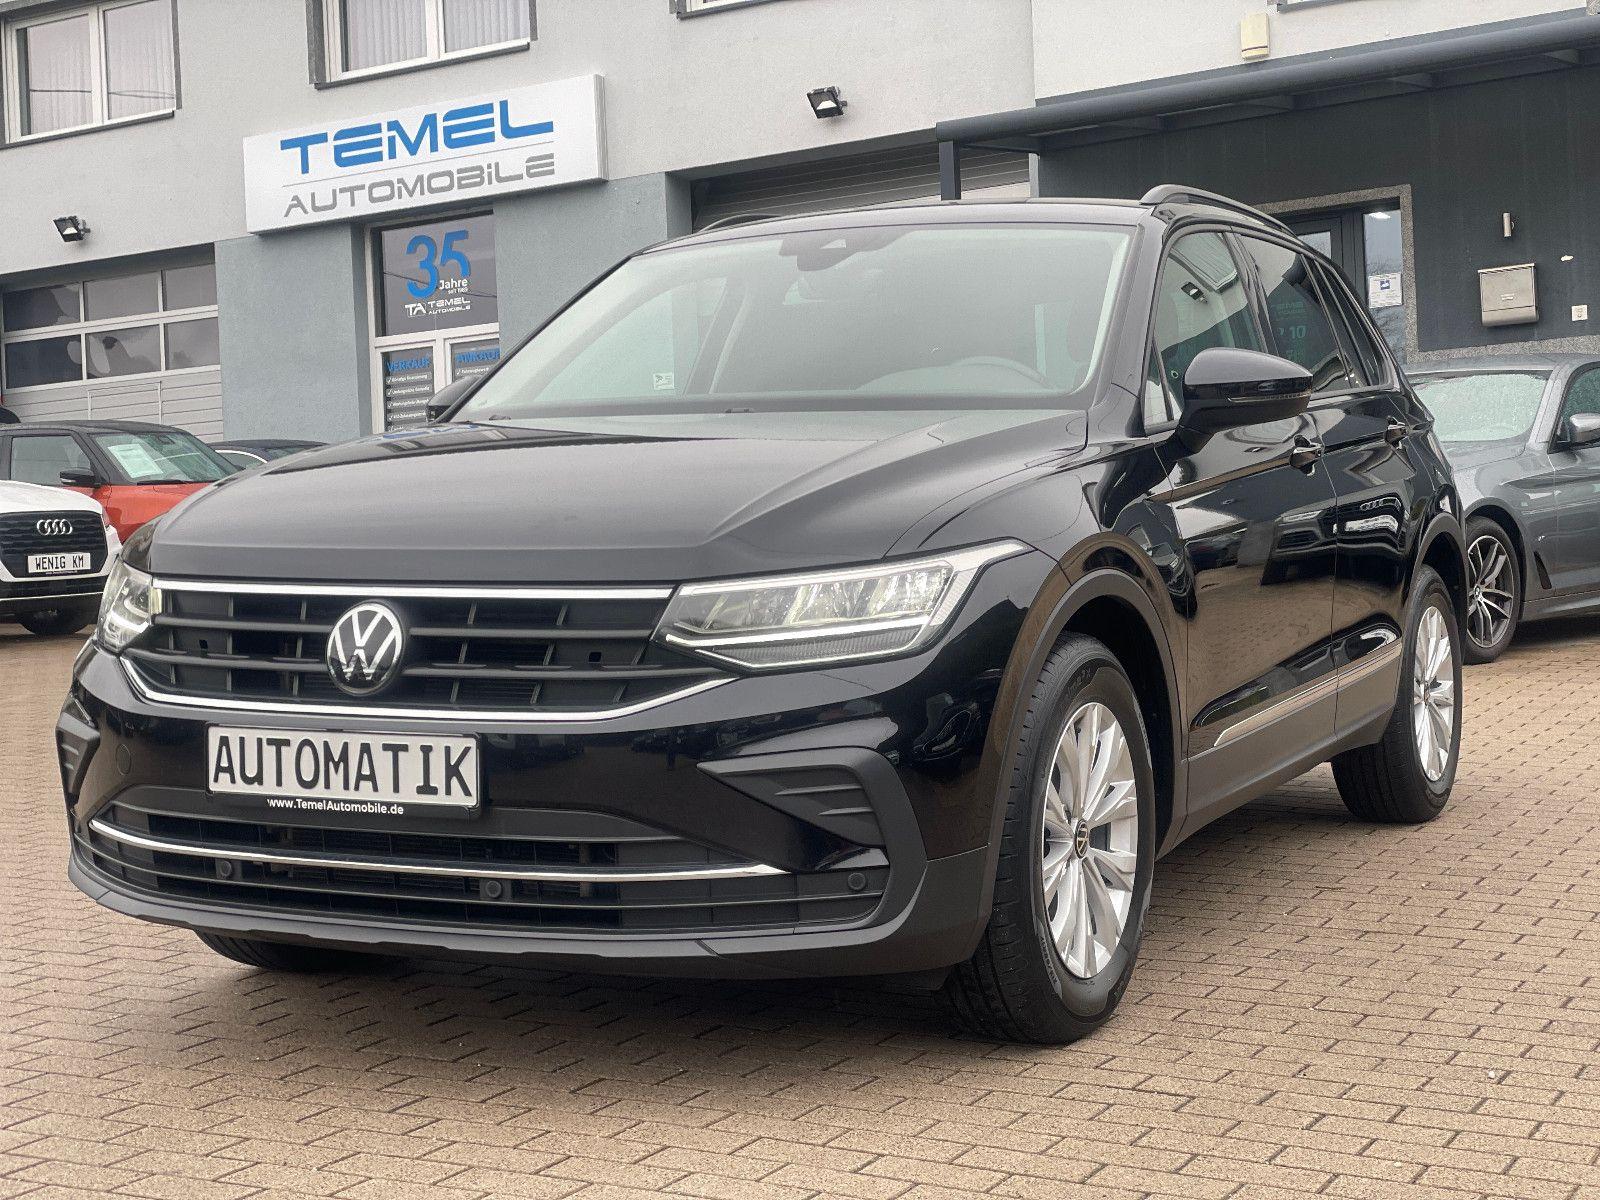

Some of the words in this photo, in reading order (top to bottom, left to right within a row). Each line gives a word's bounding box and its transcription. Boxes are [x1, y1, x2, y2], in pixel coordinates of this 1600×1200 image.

[280, 100, 554, 175] TEMEL
[406, 229, 471, 299] 35
[439, 278, 468, 290] Jahre
[427, 297, 471, 308] TEMEL
[35, 556, 66, 570] WENIG
[72, 555, 84, 568] KM
[212, 734, 473, 797] AUTOMATIK
[266, 797, 404, 815] www.TemelAutomobile.de
